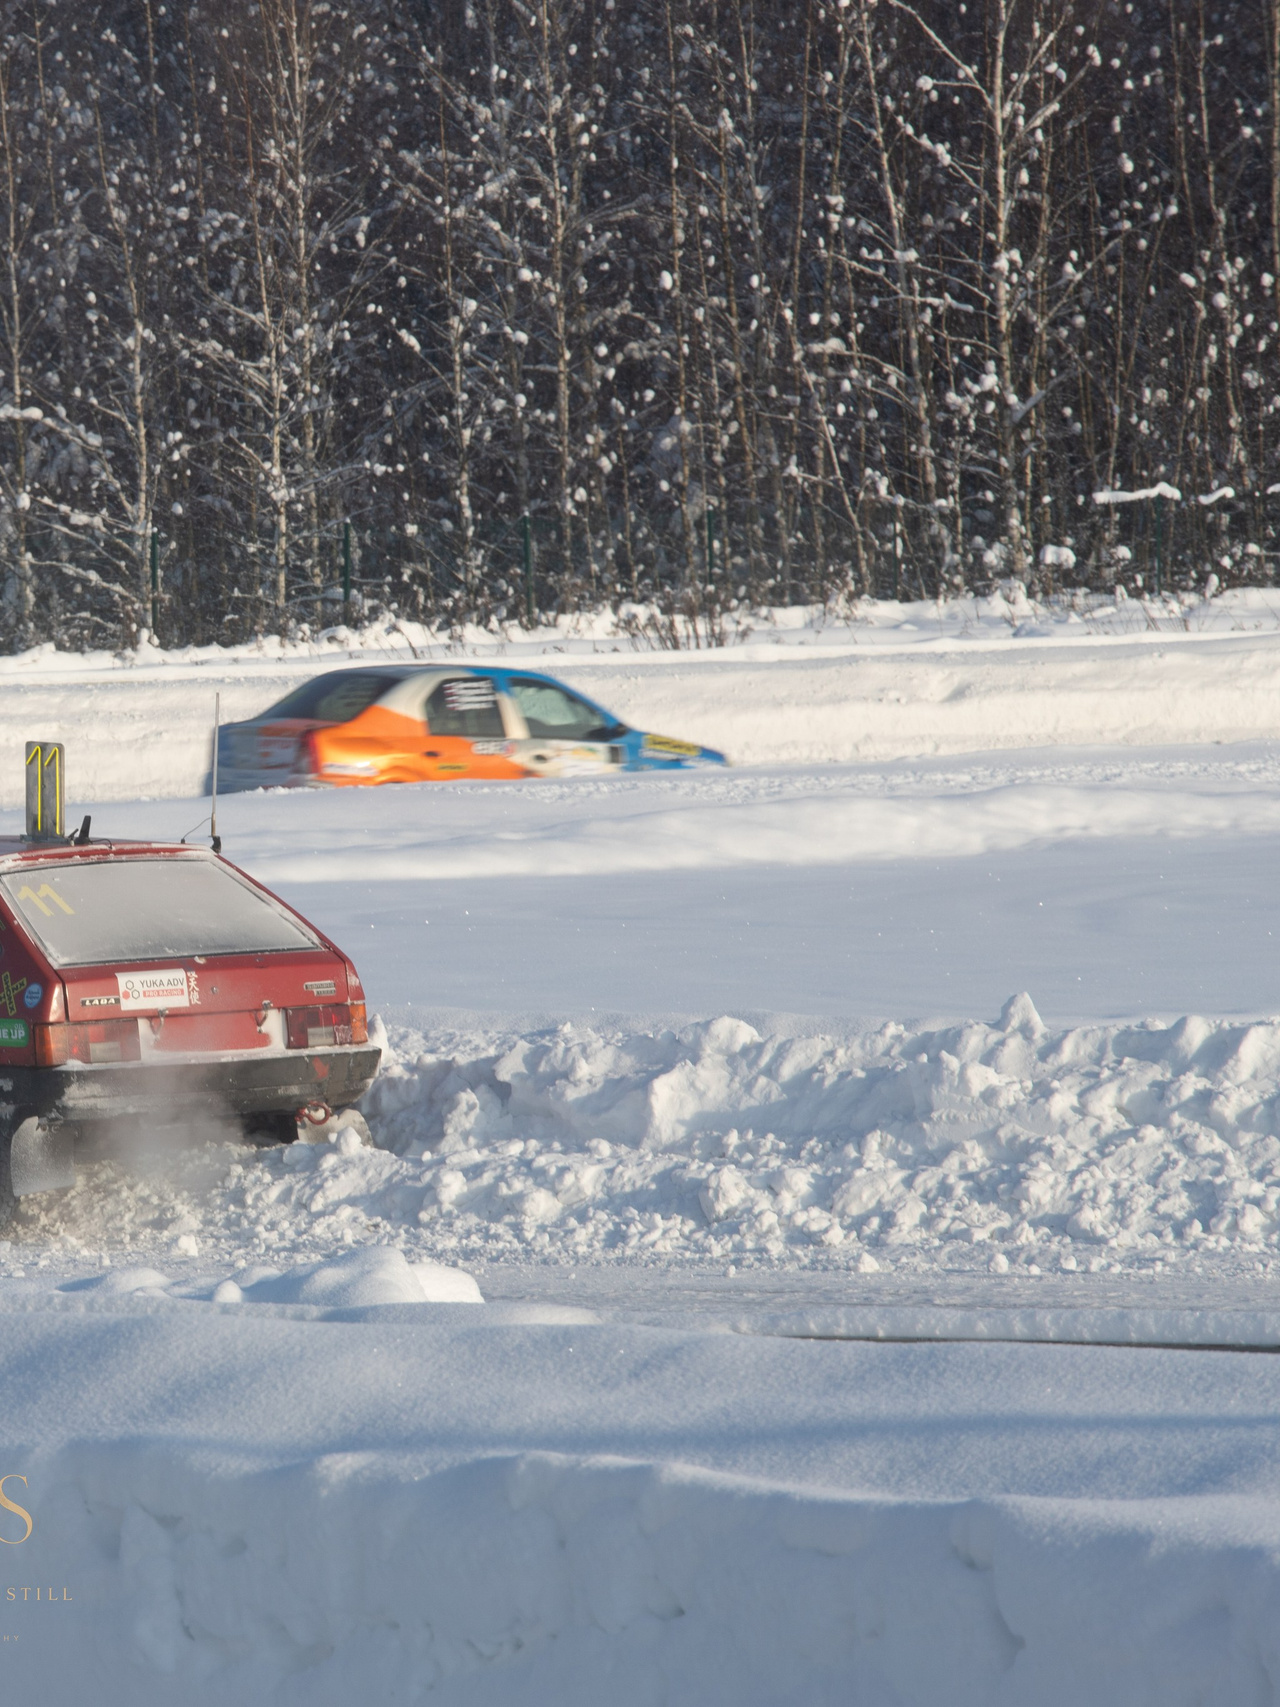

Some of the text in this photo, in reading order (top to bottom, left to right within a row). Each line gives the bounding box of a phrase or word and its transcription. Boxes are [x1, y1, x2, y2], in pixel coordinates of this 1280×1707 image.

[25, 745, 61, 836] 11
[18, 884, 75, 917] 11
[140, 978, 185, 989] YUKA ADV
[10, 1029, 25, 1039] UP
